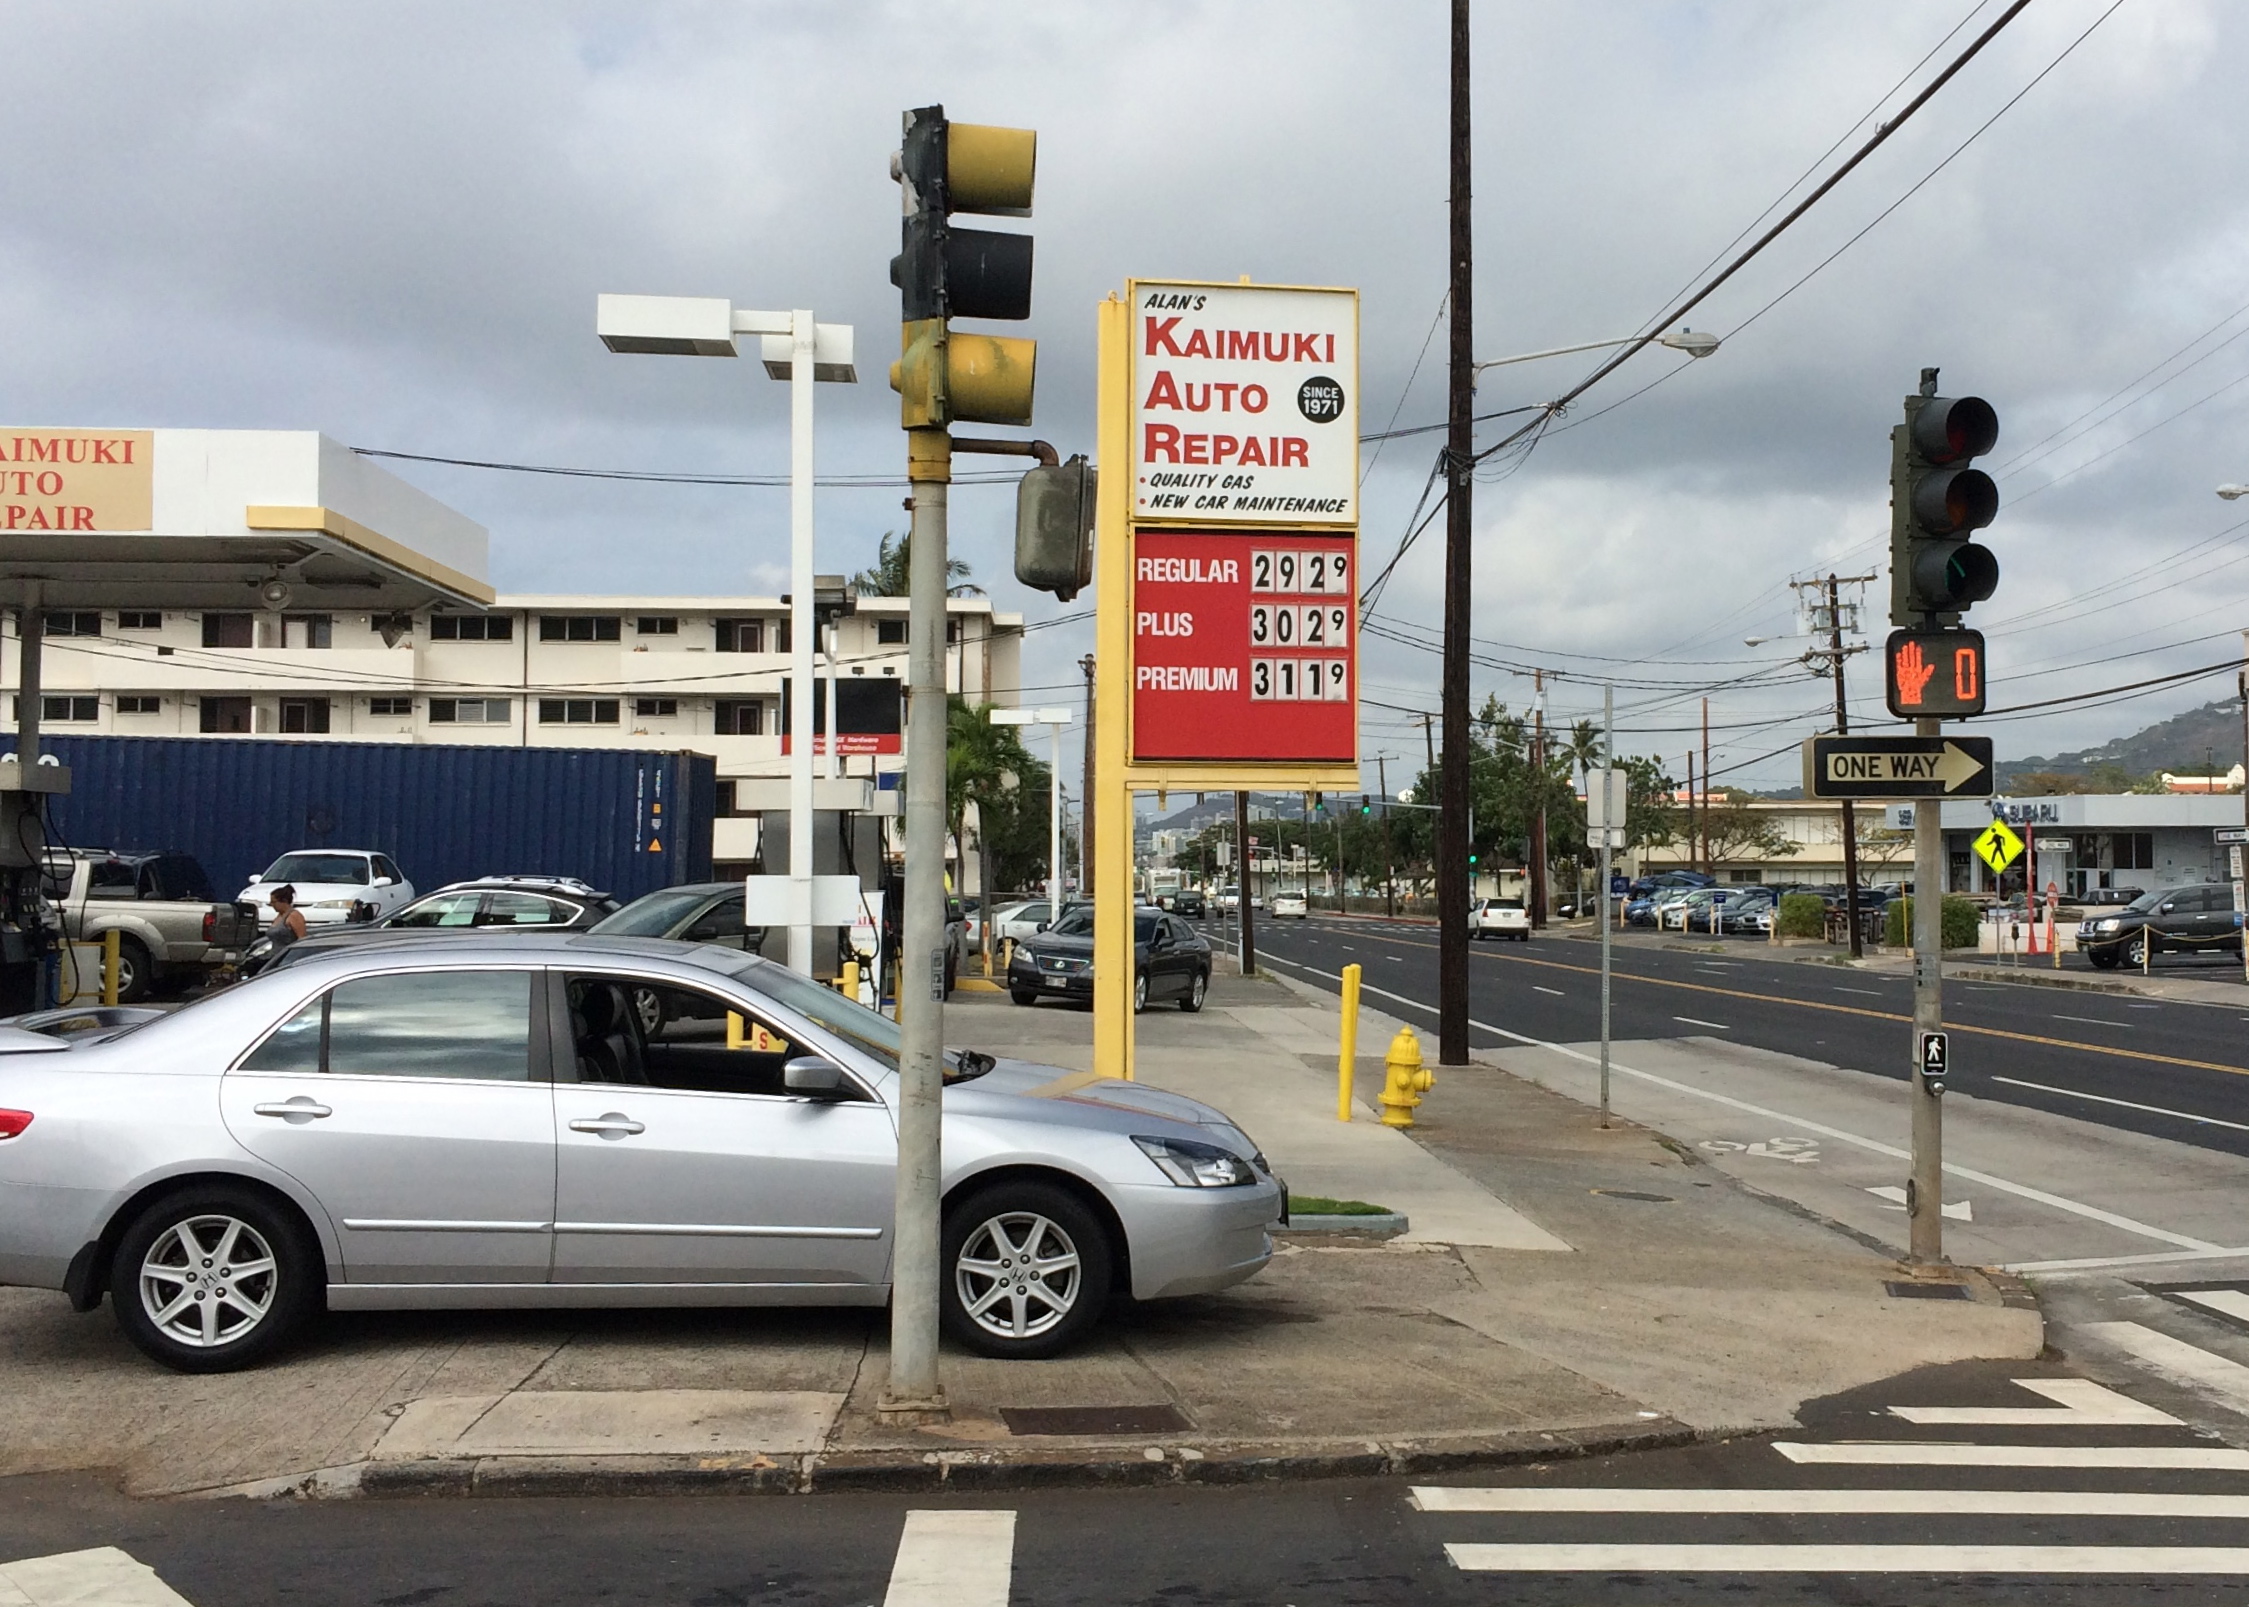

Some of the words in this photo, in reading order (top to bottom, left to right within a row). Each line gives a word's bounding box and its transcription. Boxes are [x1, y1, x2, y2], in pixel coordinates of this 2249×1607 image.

[1144, 293, 1207, 311] ALAN'S
[1145, 316, 1335, 363] KAIMUKI
[1143, 370, 1268, 413] AUTO
[1303, 386, 1339, 399] SINCE
[1303, 400, 1339, 415] 1971
[1144, 423, 1309, 467] REPAIR
[1150, 473, 1218, 489] QUALITY
[1221, 475, 1254, 490] GAS
[1150, 494, 1189, 509] NEW
[1195, 495, 1228, 510] CAR
[1233, 496, 1348, 513] MAINTENANCE
[0, 505, 97, 531] PAIR
[1137, 558, 1239, 583] REGULAR
[1137, 612, 1194, 637] PLUS
[1137, 666, 1239, 691] PREMIUM
[1833, 755, 1882, 778] ONE
[1890, 755, 1940, 778] WAY
